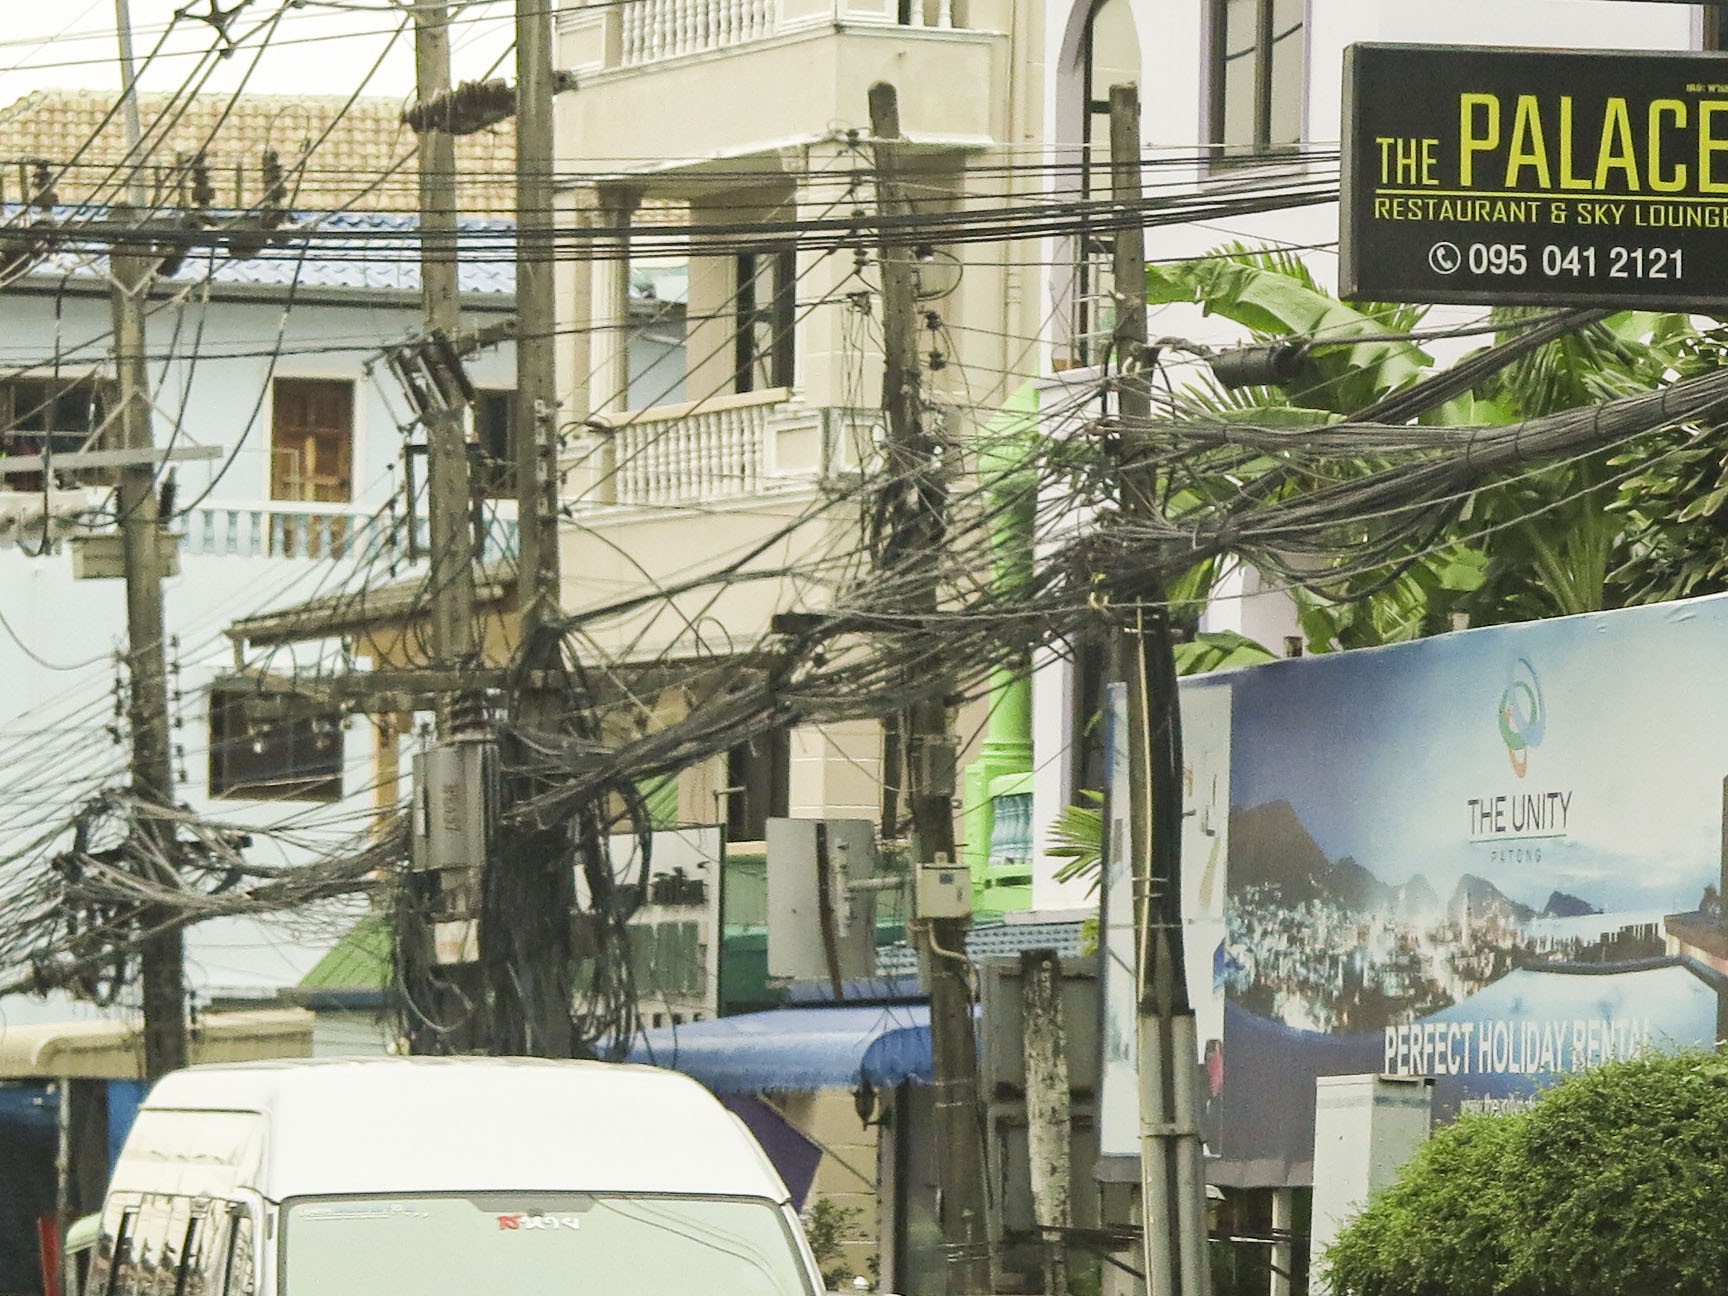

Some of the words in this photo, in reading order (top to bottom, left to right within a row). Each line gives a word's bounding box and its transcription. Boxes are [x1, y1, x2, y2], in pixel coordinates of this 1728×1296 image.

[1376, 137, 1439, 185] THE
[1375, 198, 1541, 223] RESTAURANT
[1551, 202, 1566, 224] &
[1577, 203, 1625, 225] SKY
[1468, 243, 1527, 275] 095
[1542, 245, 1596, 277] 041
[1609, 247, 1682, 279] 2121
[1468, 796, 1506, 835] THE
[1513, 791, 1572, 831] UNITY
[1384, 1022, 1474, 1075] PERFECT
[1478, 1019, 1568, 1073] HOLIDAY
